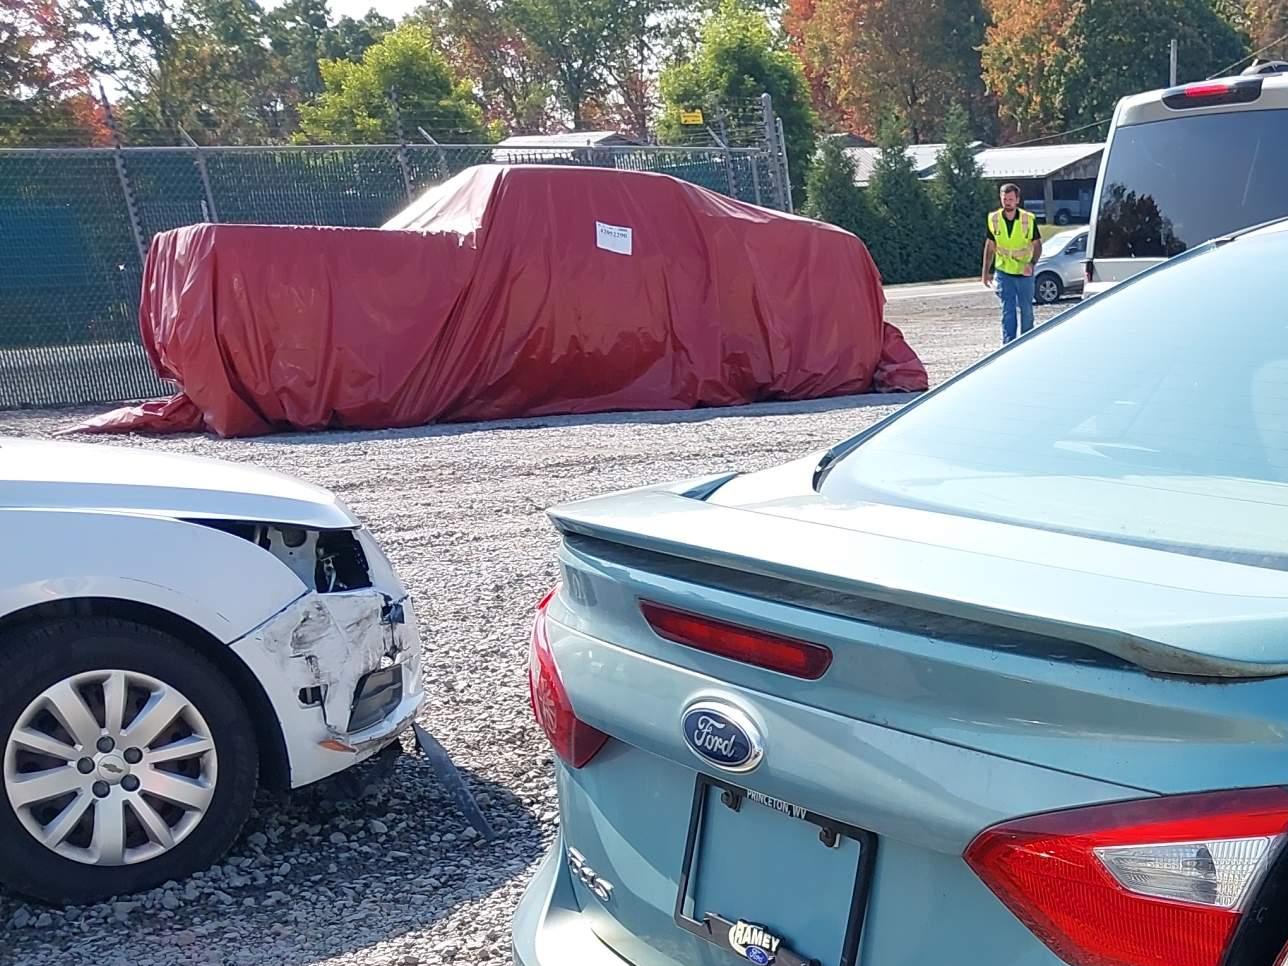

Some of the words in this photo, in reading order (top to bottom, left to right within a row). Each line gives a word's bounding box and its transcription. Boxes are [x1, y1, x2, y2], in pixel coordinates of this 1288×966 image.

[694, 715, 736, 758] Ford
[746, 789, 791, 816] PRINCETON,
[792, 805, 807, 820] WV
[735, 920, 781, 952] RAMEY
